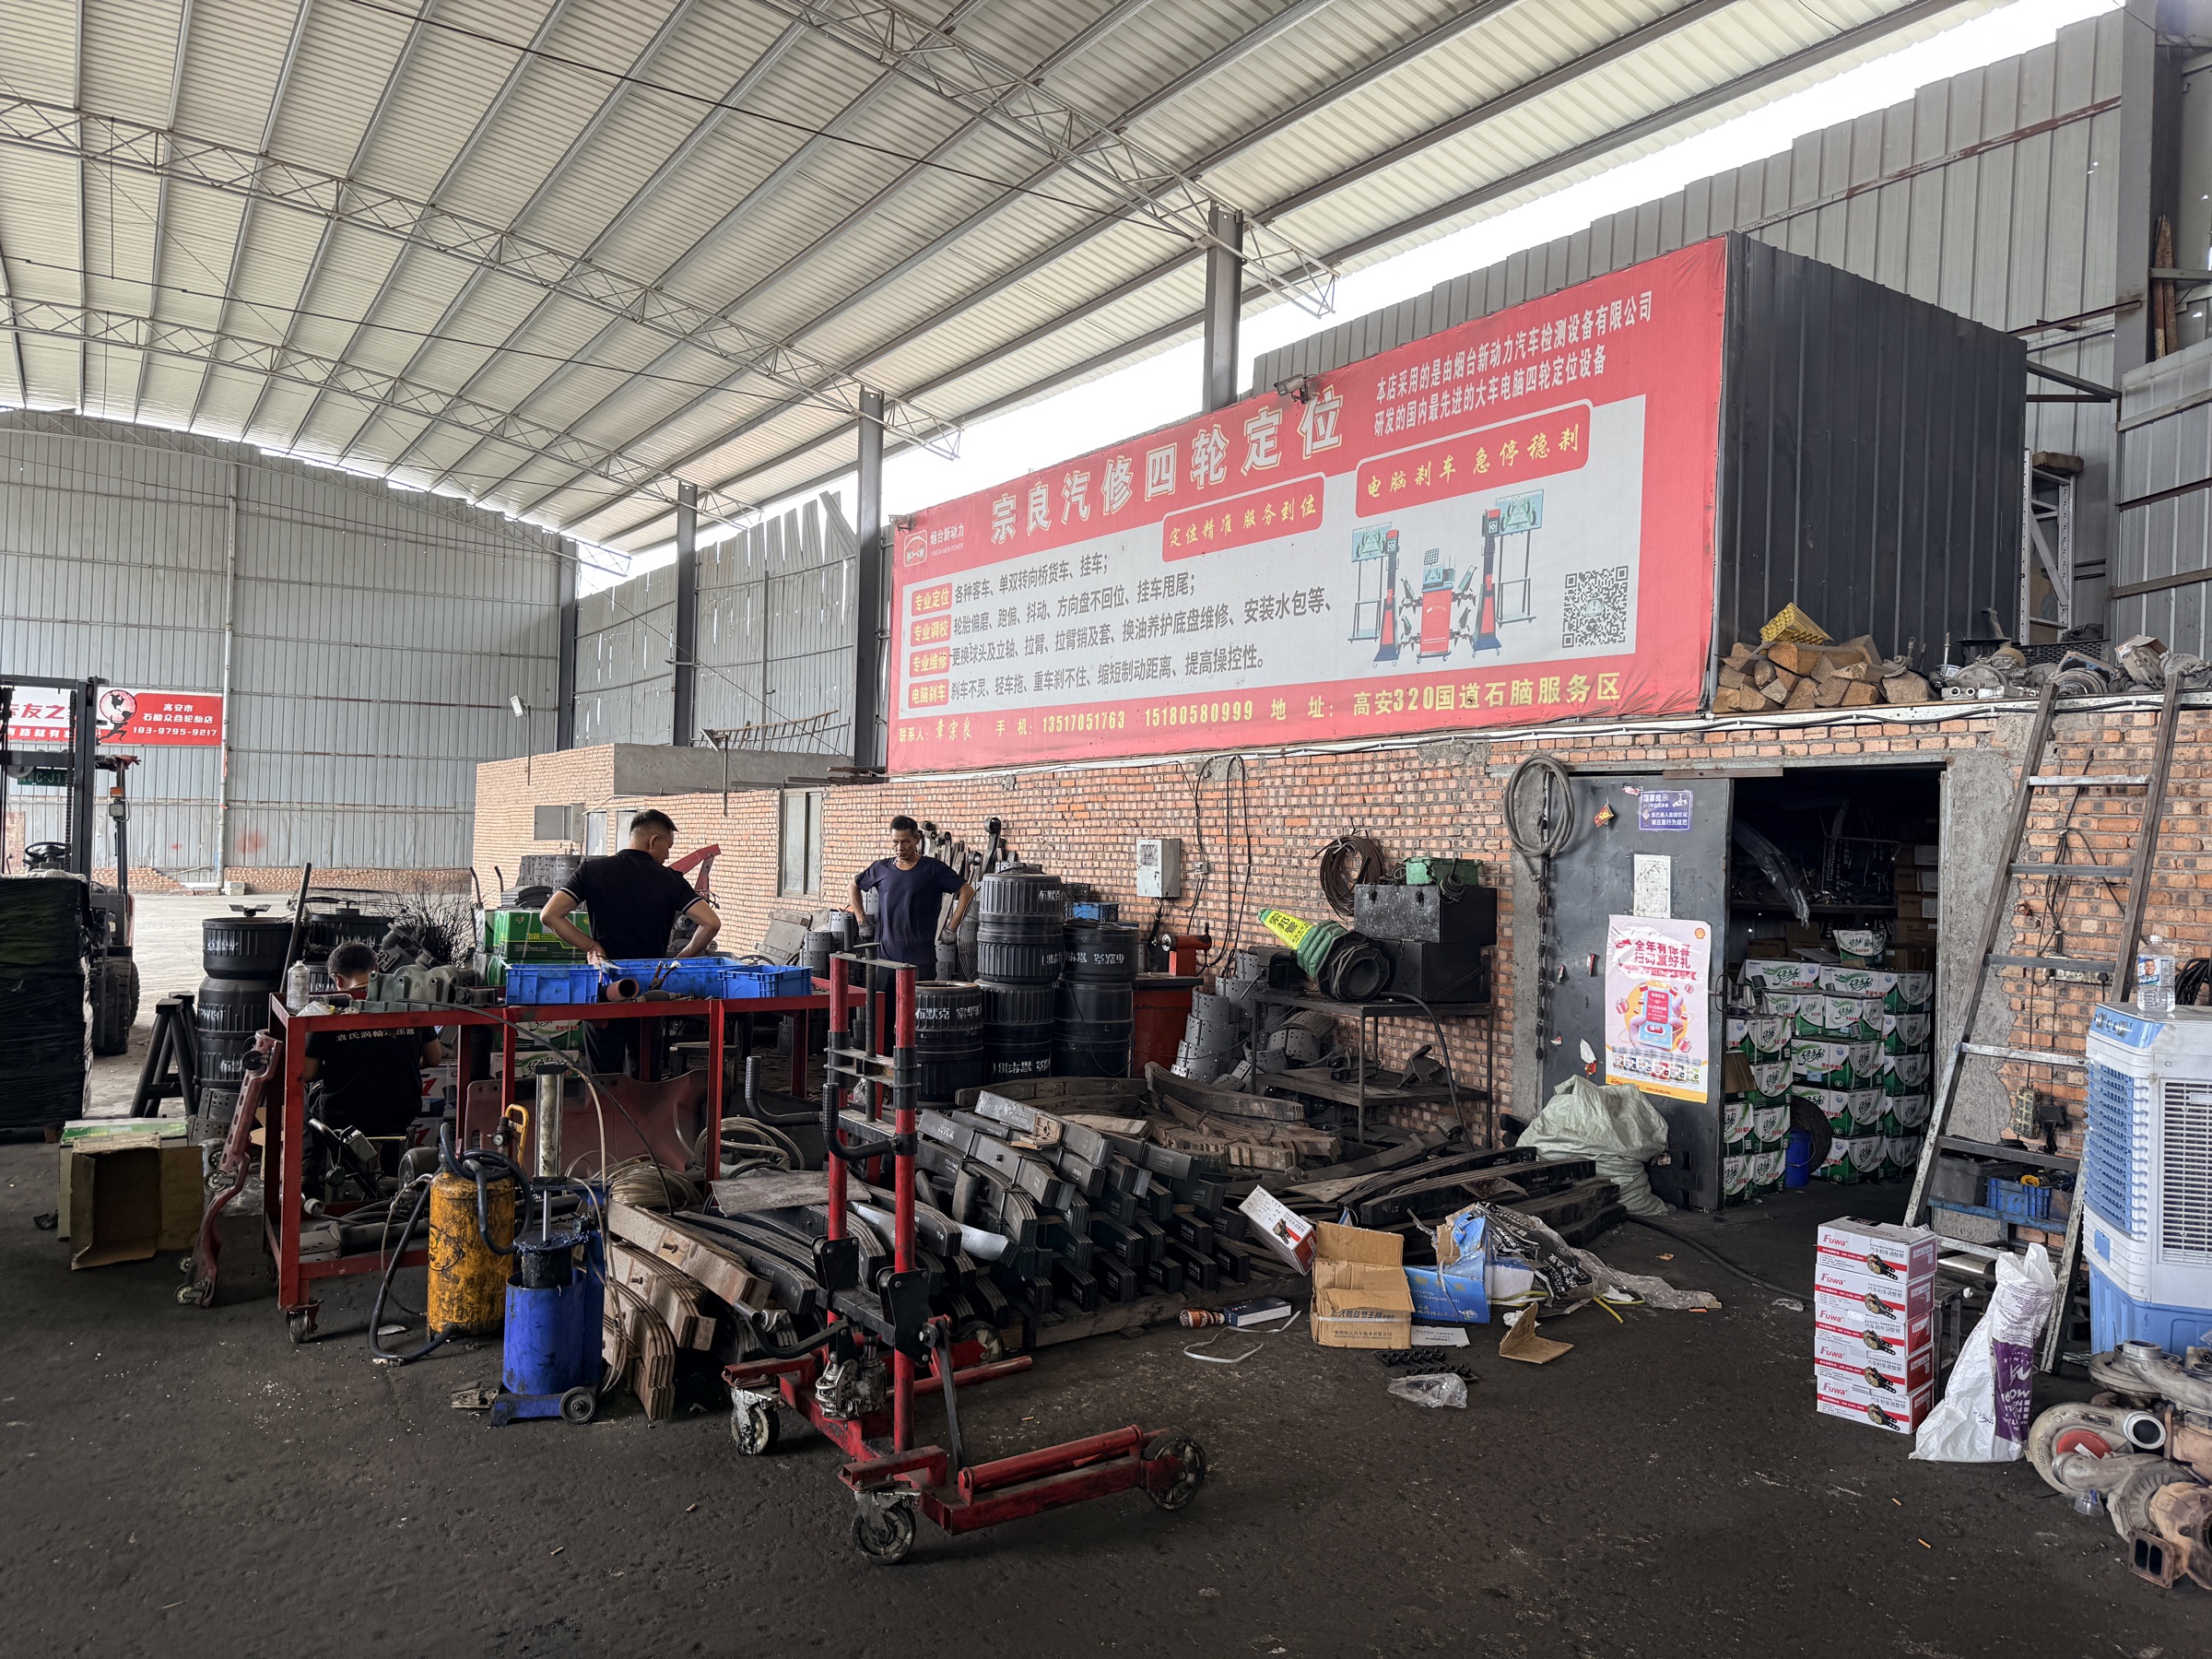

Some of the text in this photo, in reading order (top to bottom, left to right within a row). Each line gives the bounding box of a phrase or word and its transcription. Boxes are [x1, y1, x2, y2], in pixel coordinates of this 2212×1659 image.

[1376, 290, 1653, 404] 本店采用的是由烟台新动力汽车检测设备有限公司
[1373, 344, 1606, 437] 研发的国内最先进的大车电脑四轮定位设备
[991, 385, 1343, 544] 宗良汽修四轮定位
[1366, 423, 1580, 498] 电脑刹车 急停稳刹
[1169, 493, 1317, 547] 定位精准 服务到位
[930, 523, 964, 546] 烟台新动力
[914, 588, 949, 612] 专业定位
[913, 619, 948, 642] 专业调校
[912, 653, 947, 674] 专业维修
[912, 683, 947, 704] 电脑刹车
[1042, 711, 1125, 733] 13517051763
[1145, 700, 1253, 726] 15180580999
[1353, 672, 1621, 717] 高安320国道石脑服务区
[163, 703, 194, 712] 高安市
[133, 726, 218, 736] 183-9795-9217
[1823, 1234, 1846, 1247] Fuwa
[1820, 1273, 1844, 1286] Fuwa
[1819, 1309, 1841, 1323] Fuwa
[1820, 1346, 1843, 1359] Fuwa
[1823, 1382, 1846, 1395] Fuwa
